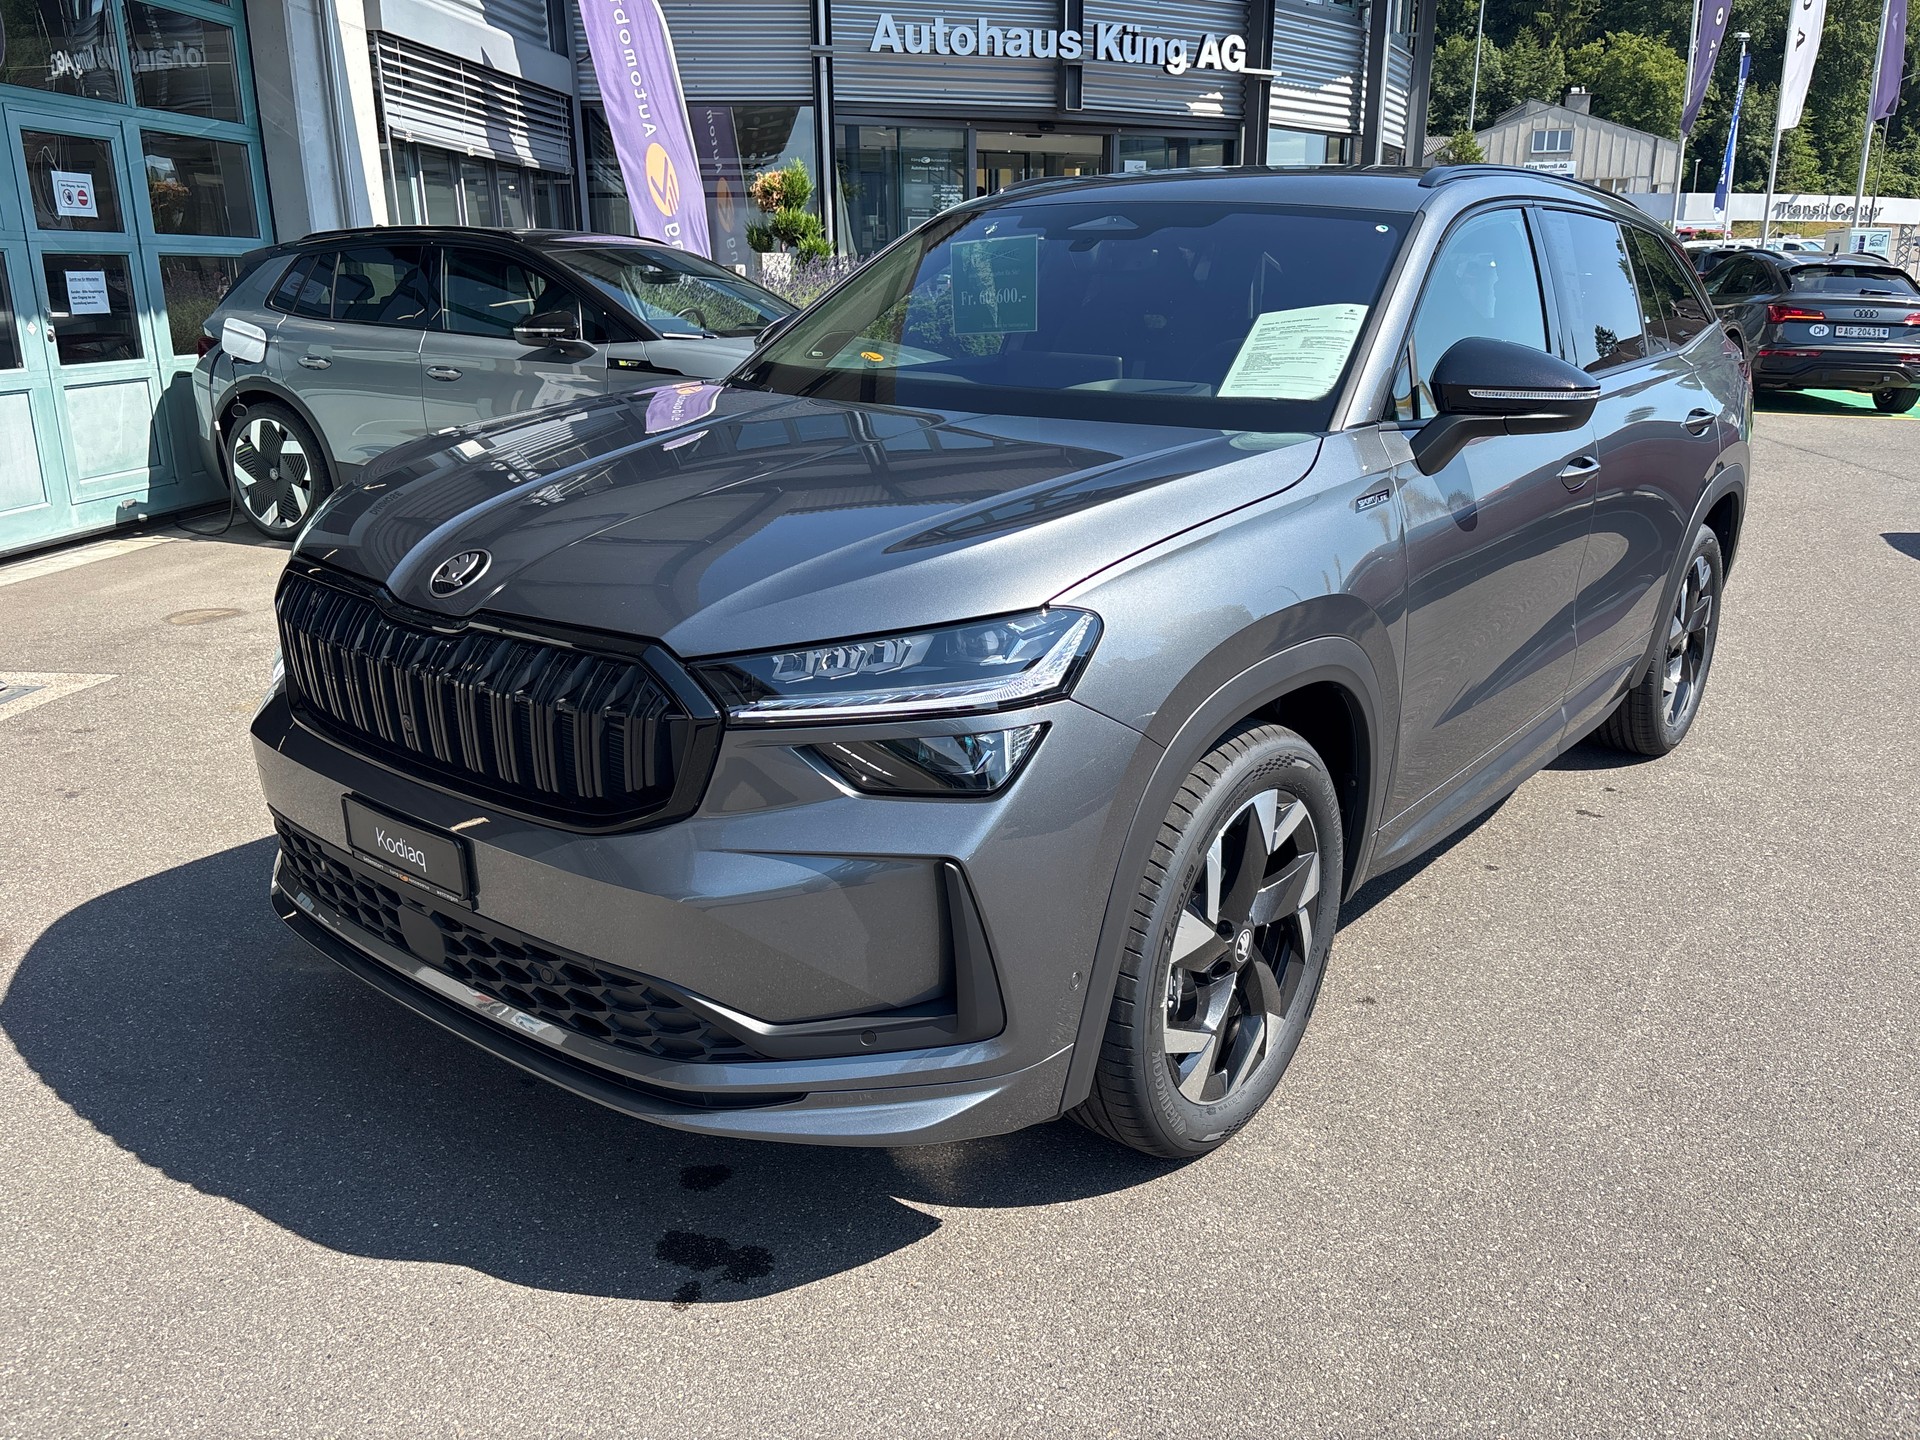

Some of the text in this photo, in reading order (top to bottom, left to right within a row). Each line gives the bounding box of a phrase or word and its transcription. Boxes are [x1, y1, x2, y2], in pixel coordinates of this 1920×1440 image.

[870, 13, 1247, 75] Autohaus Küng AG
[1779, 201, 1830, 216] Transit
[961, 290, 977, 306] Fr.
[1813, 326, 1825, 336] CH
[375, 827, 427, 873] Kodiaq
